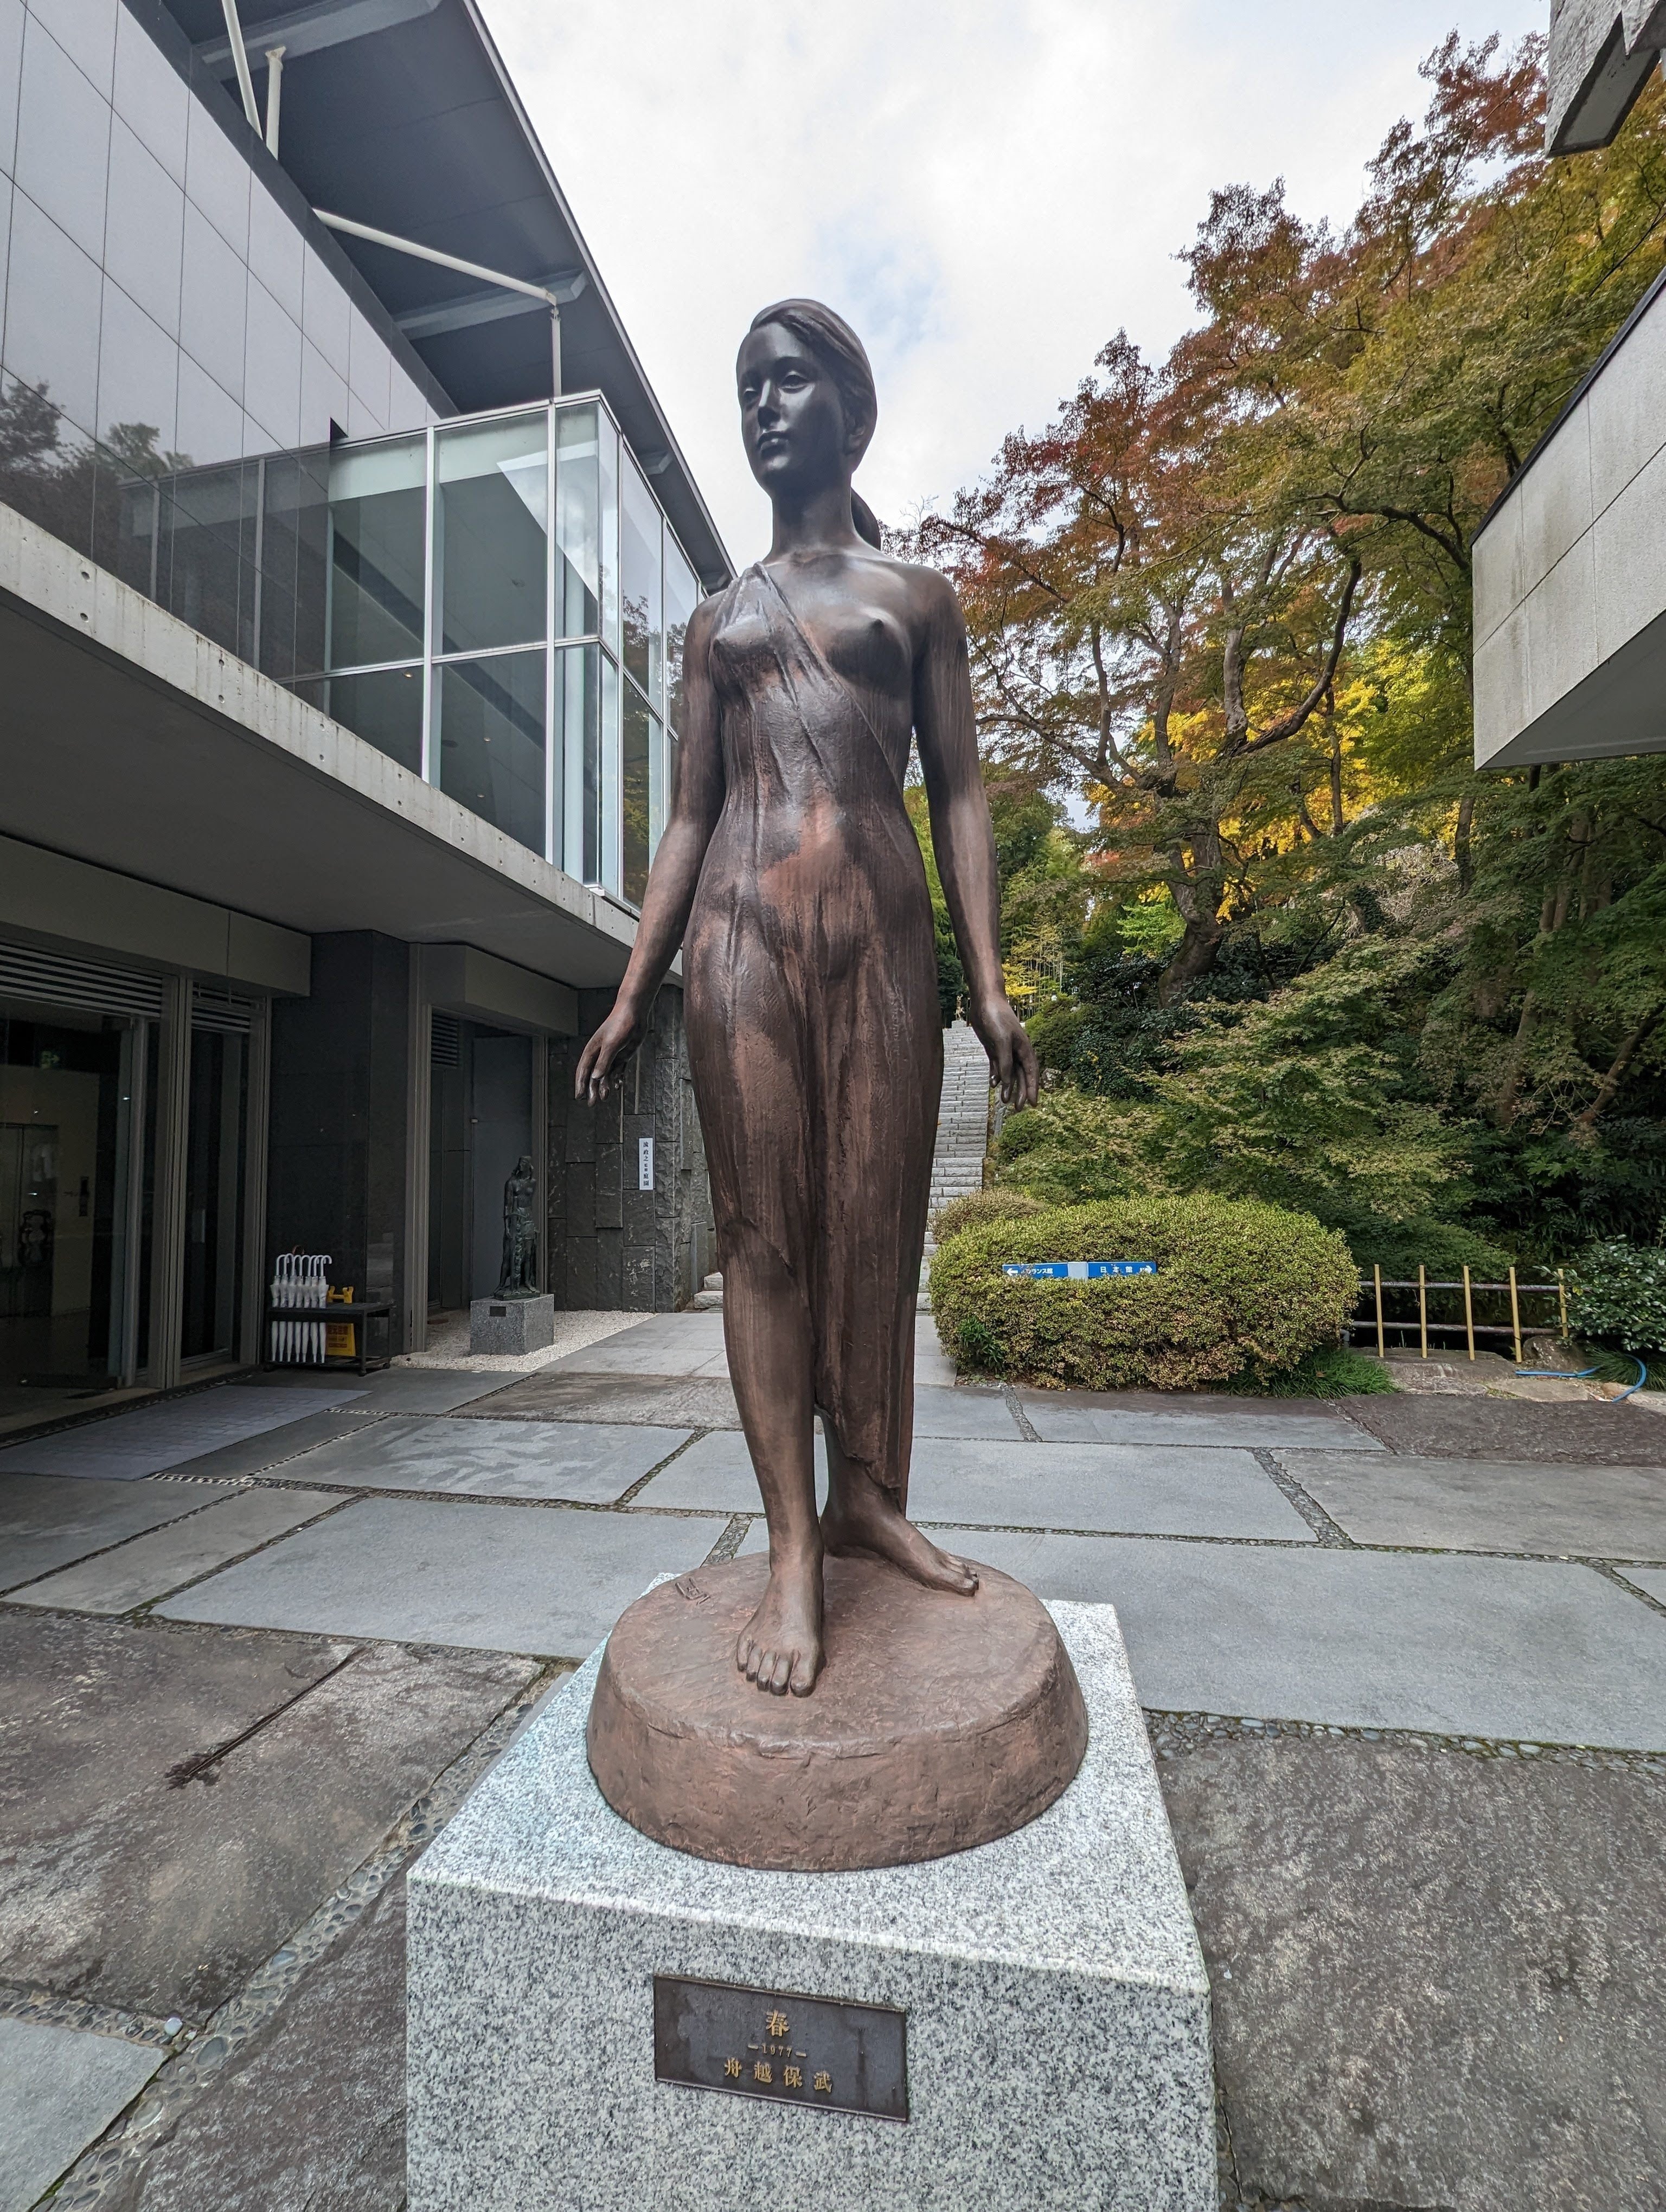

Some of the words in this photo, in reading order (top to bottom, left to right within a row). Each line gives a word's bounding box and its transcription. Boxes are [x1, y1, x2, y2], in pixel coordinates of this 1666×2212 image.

[765, 2009, 790, 2037] 春
[725, 2057, 833, 2093] 舟越保武
